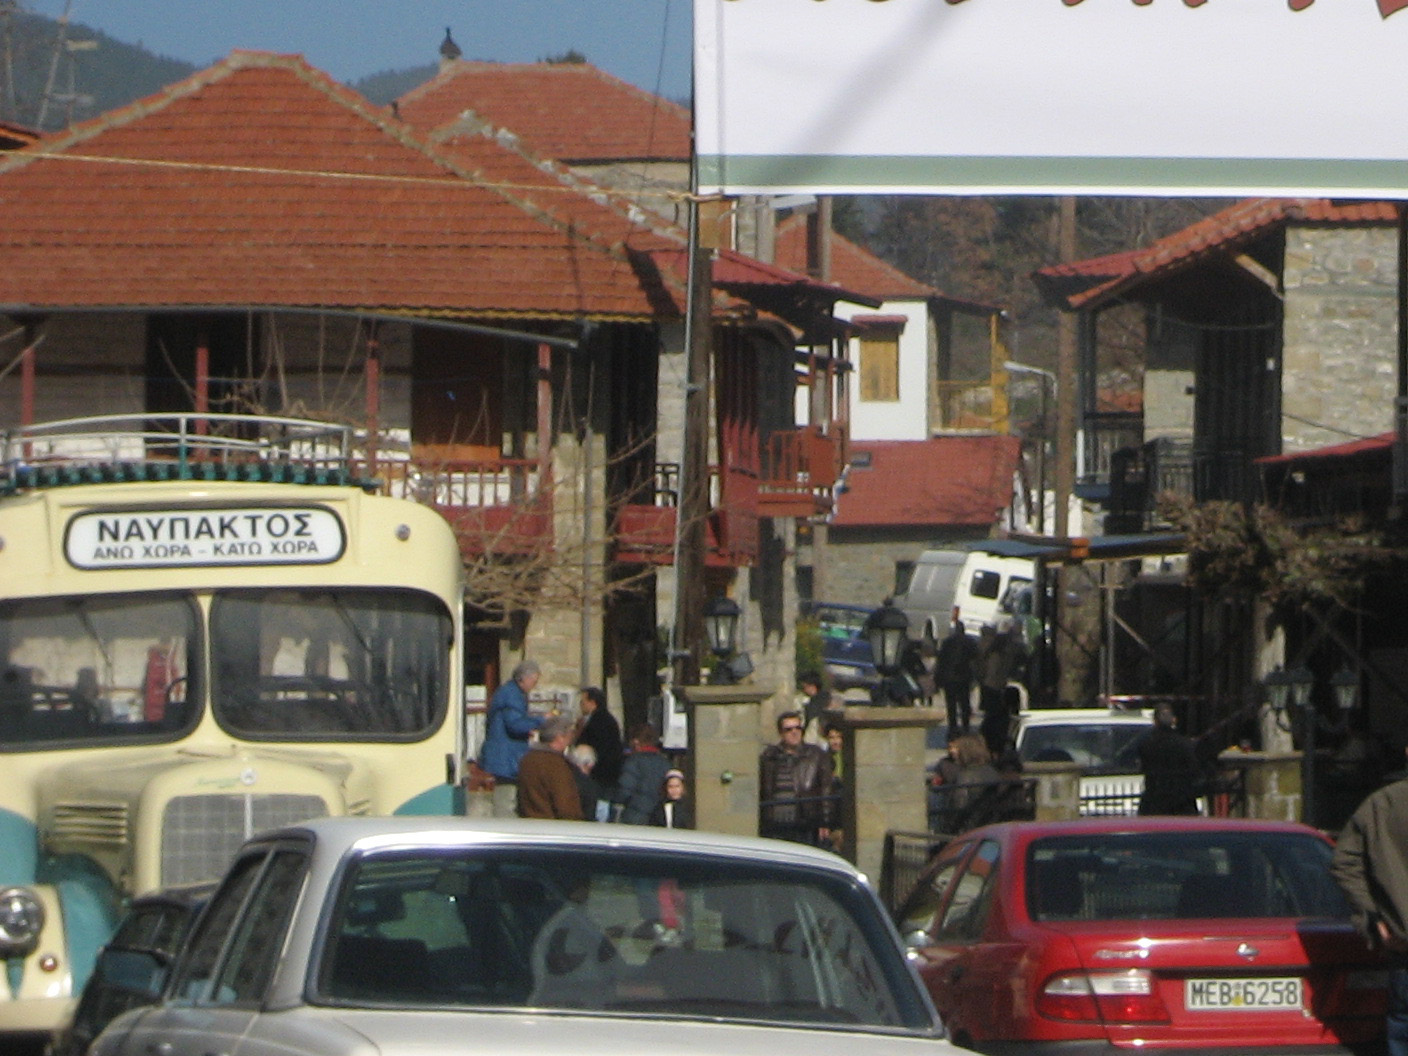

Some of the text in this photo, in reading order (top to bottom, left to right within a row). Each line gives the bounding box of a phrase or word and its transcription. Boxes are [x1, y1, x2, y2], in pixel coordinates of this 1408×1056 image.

[98, 513, 312, 542] ΝΑΥΠΑΚΤΟΣ
[93, 546, 134, 560] ΑΝΩ
[143, 544, 192, 558] ΧΩΡΑ
[213, 541, 262, 556] ΚΑΤΩ
[270, 540, 319, 555] ΧΩΡΑ
